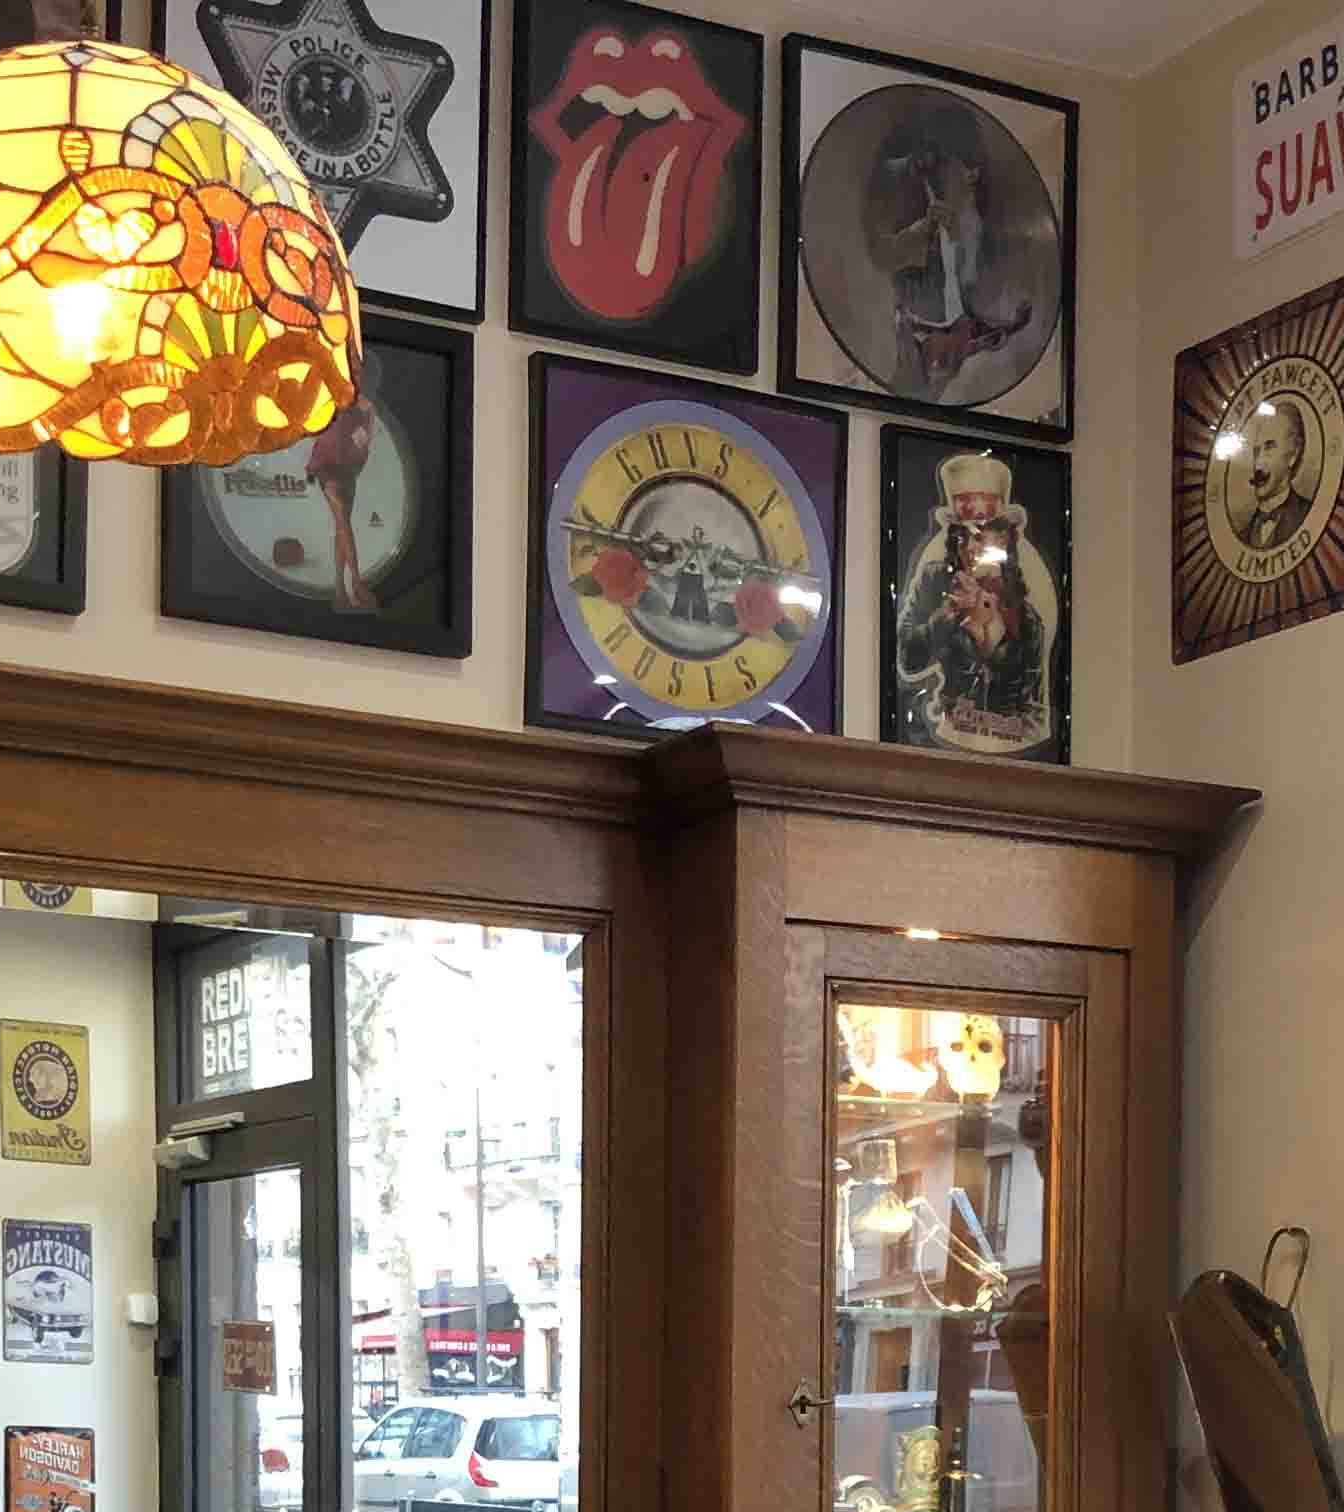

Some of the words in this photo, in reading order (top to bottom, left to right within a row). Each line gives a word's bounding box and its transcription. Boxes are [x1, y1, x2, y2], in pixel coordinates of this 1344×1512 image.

[289, 36, 370, 70] POLICE
[1260, 363, 1338, 417] FAWCETT
[1234, 528, 1312, 579] LIMITED
